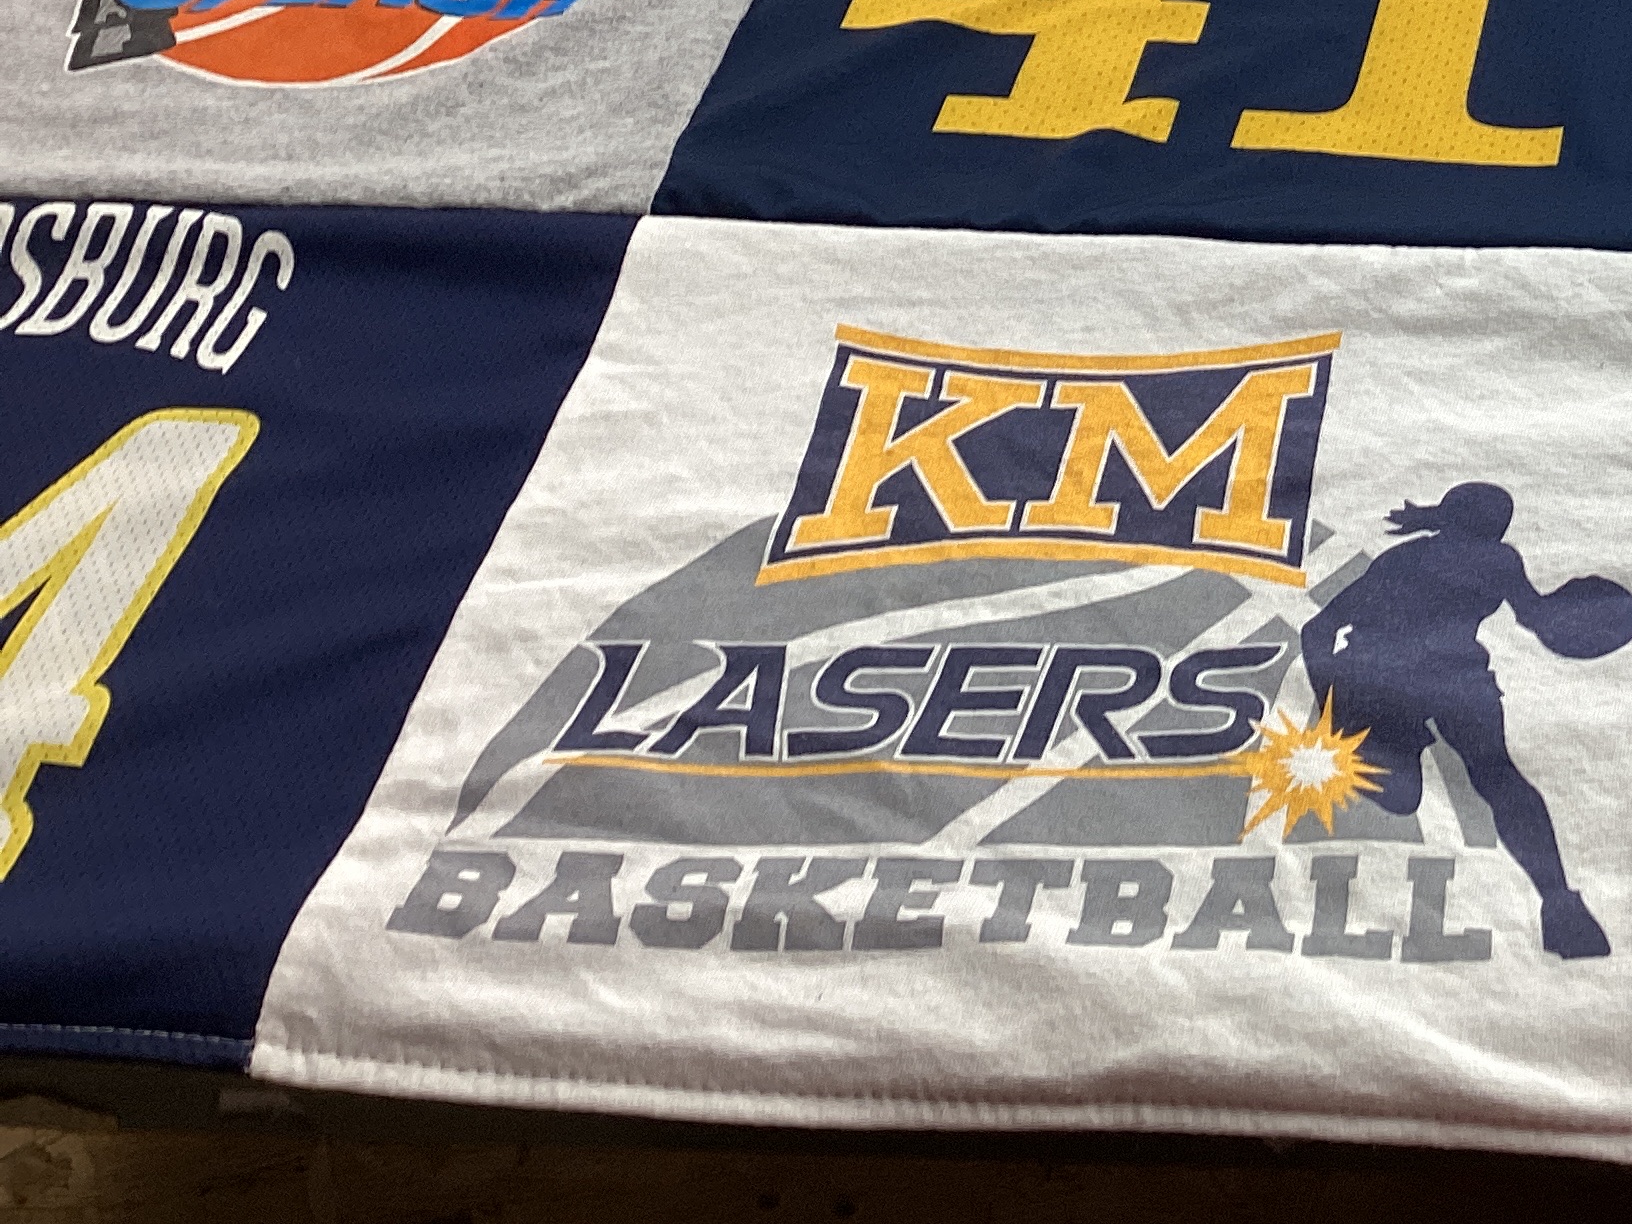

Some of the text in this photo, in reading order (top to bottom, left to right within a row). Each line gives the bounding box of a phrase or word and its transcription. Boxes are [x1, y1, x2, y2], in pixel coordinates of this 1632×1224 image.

[0, 201, 295, 376] SBURG
[780, 346, 1324, 558] KM
[544, 638, 1287, 766] LASERS
[384, 850, 1494, 961] BASKETBALL
